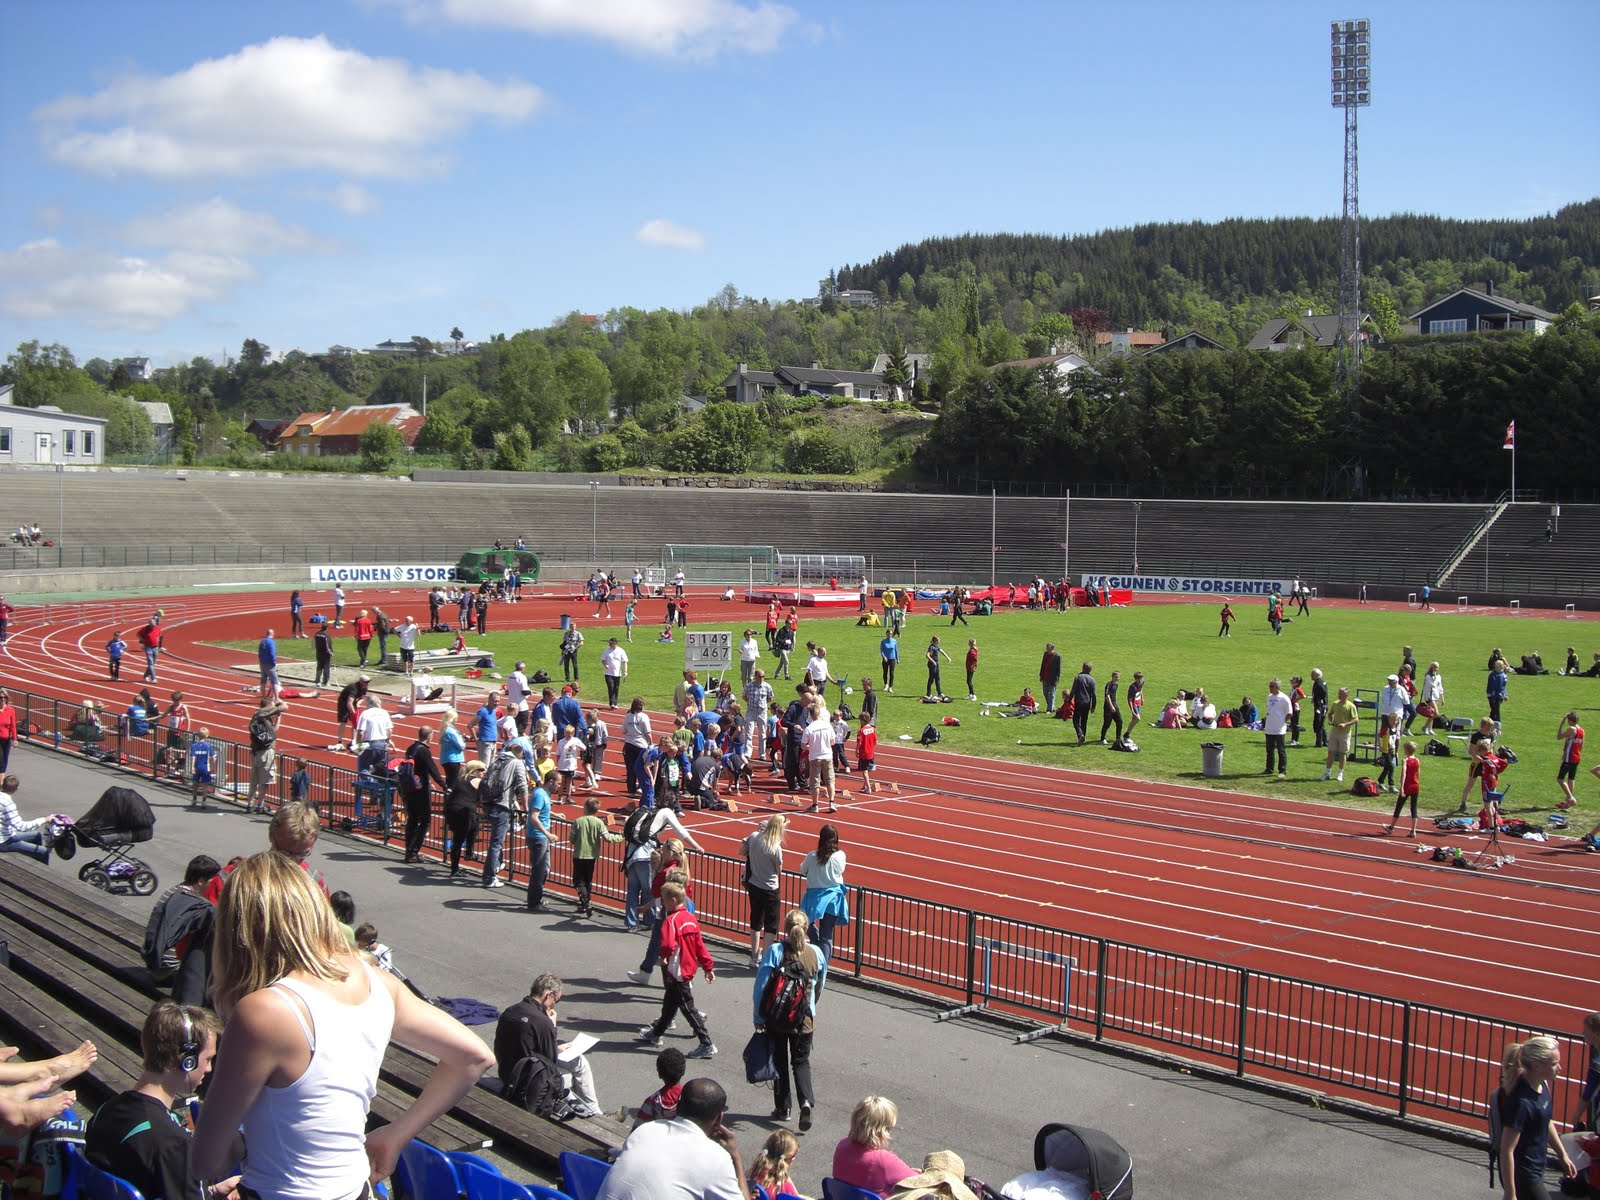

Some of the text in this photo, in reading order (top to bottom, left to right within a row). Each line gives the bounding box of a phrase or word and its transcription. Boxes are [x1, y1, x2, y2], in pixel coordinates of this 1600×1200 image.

[319, 568, 391, 581] LAGUNEN
[1182, 579, 1282, 594] STORSENTER
[702, 647, 728, 658] 467
